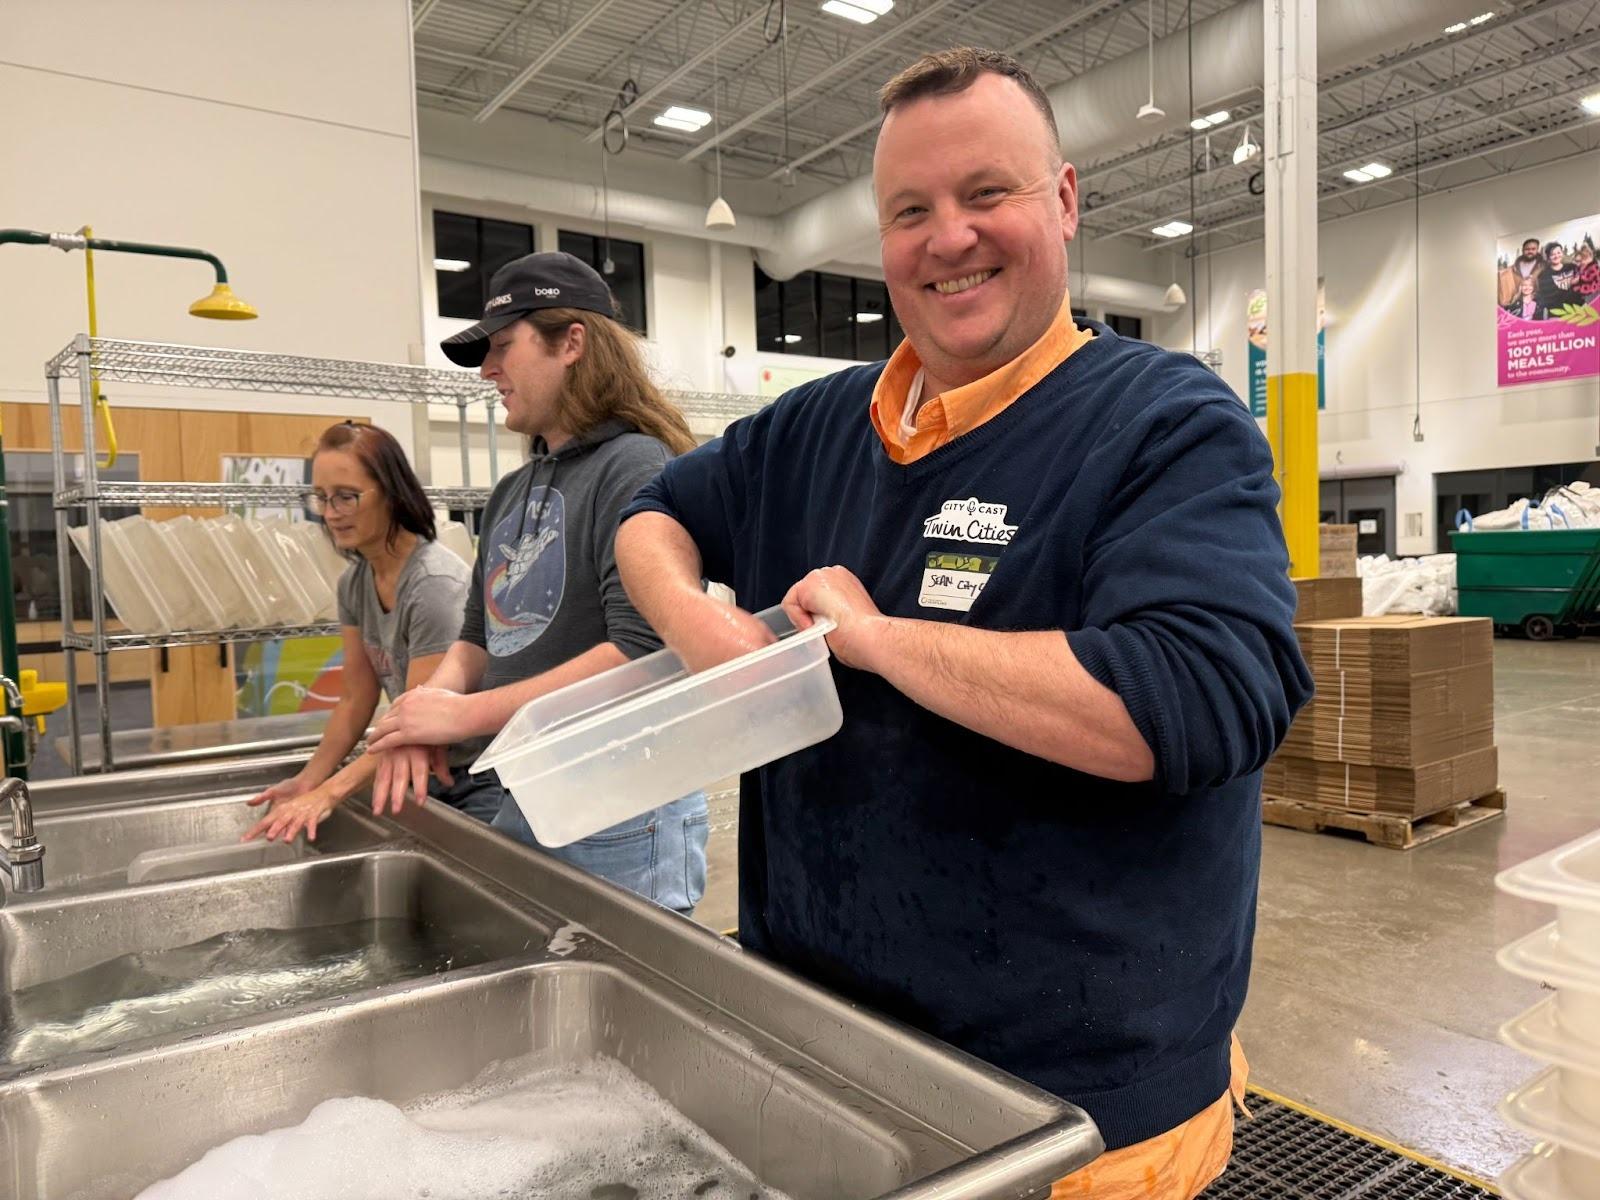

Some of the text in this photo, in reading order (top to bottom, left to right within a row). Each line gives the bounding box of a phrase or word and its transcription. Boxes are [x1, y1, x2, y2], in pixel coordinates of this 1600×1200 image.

[1507, 328, 1543, 338] Each year,
[1518, 337, 1537, 345] serve
[1538, 334, 1557, 342] more
[1558, 330, 1575, 339] than
[1507, 336, 1596, 358] 100 MILLION
[1507, 354, 1554, 371] MEALS
[1516, 369, 1527, 377] the
[1528, 366, 1571, 377] community.
[943, 502, 1005, 516] CITY CAST
[925, 517, 1017, 542] Twin Cities
[927, 574, 953, 588] SEAN
